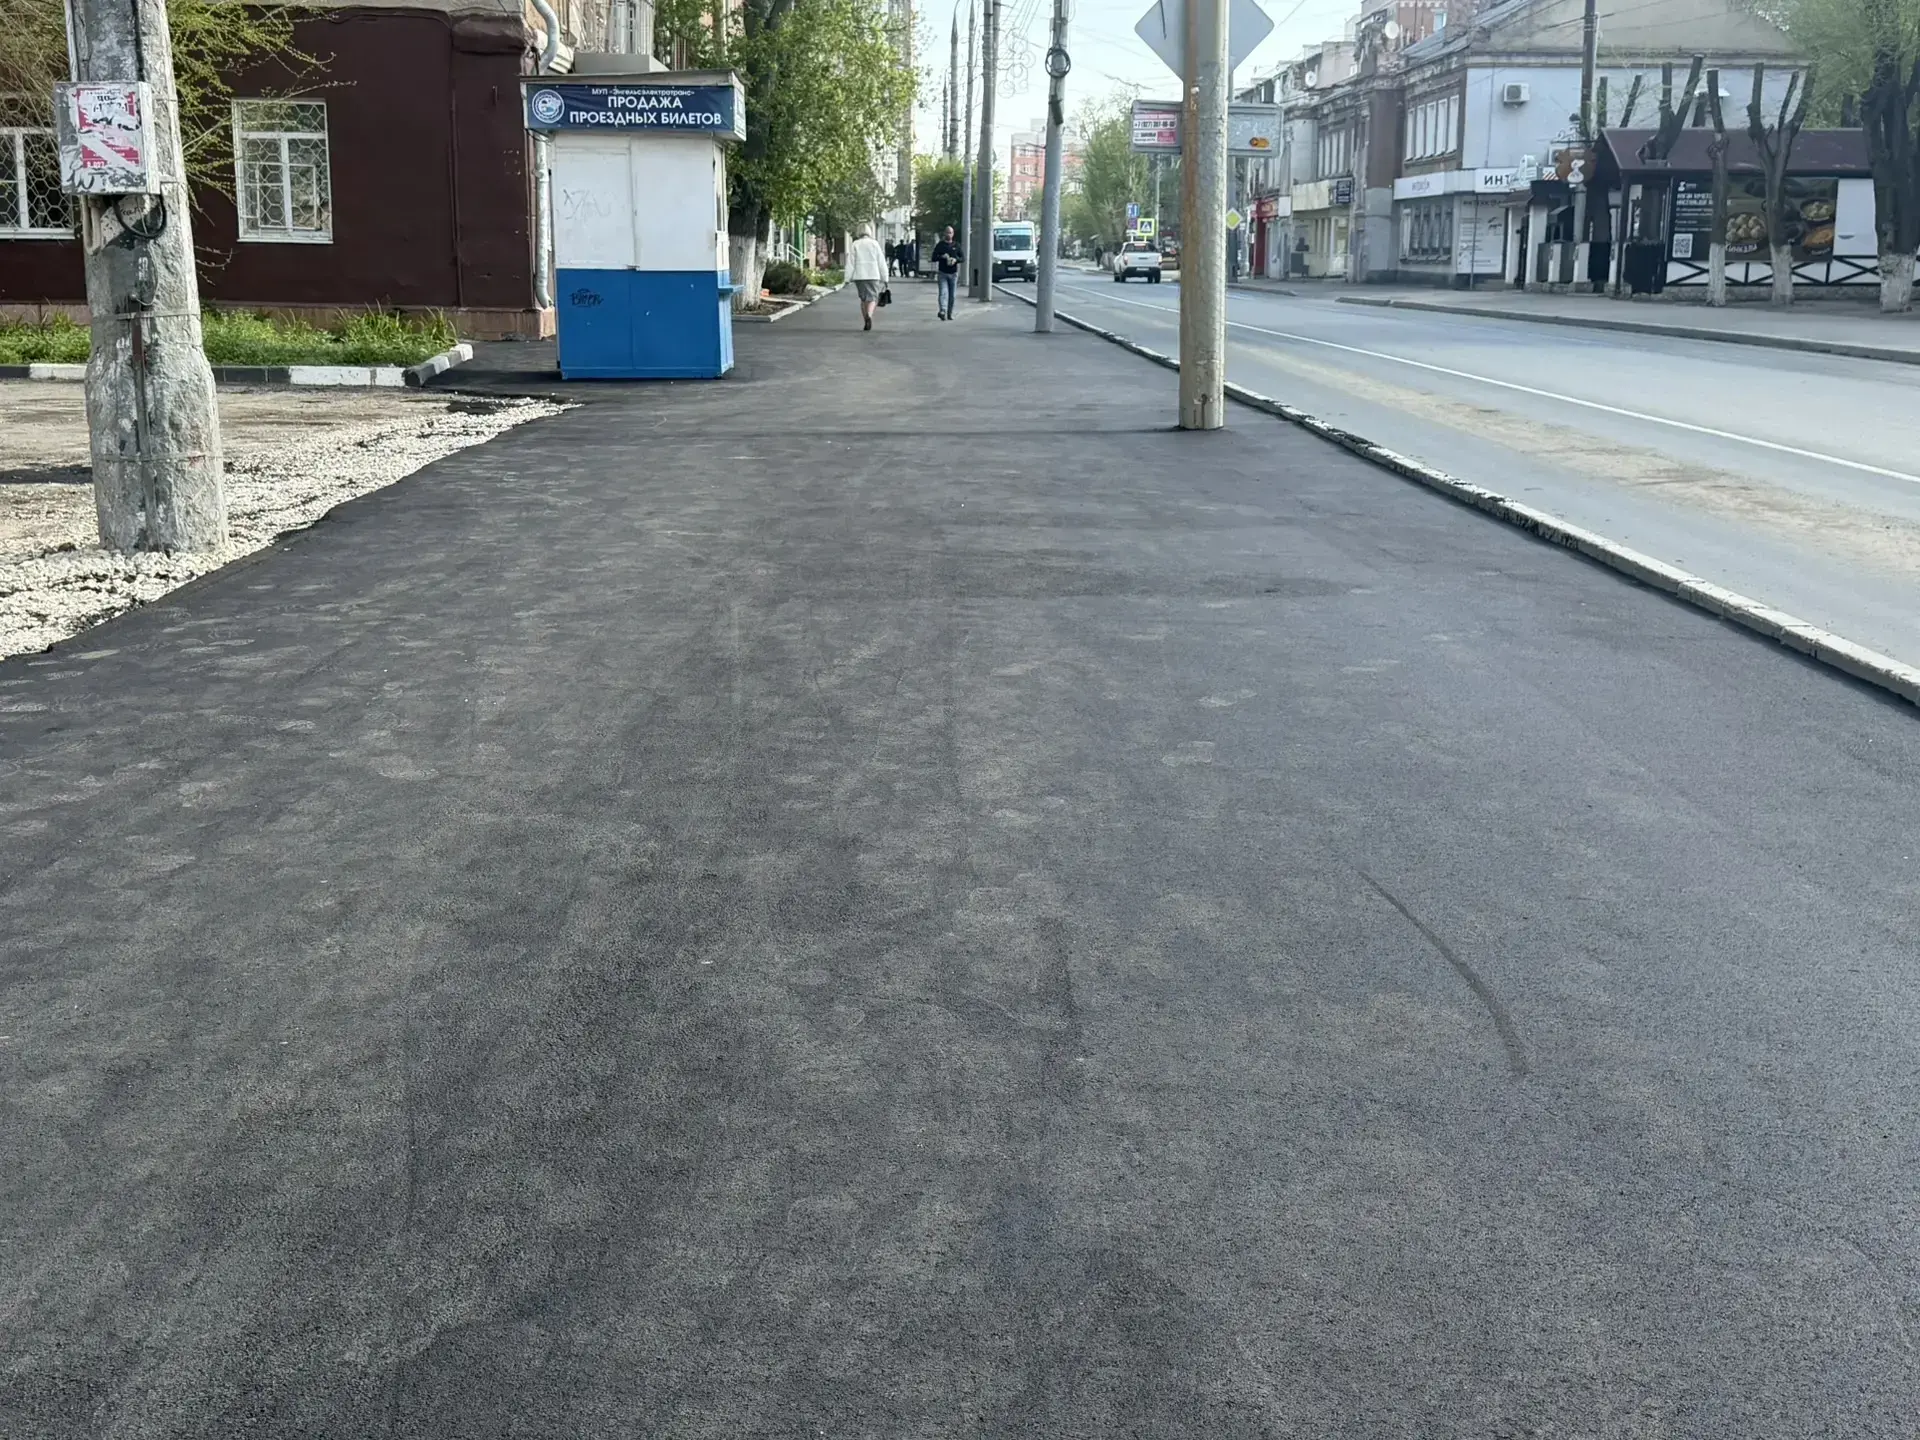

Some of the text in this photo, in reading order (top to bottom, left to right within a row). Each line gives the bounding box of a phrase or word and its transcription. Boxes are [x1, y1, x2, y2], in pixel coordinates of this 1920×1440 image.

[592, 88, 608, 96] МУП
[608, 96, 683, 110] ПРОДАЖА
[570, 111, 722, 126] ПРОЕЗДНЫХ БИЛЕТОВ
